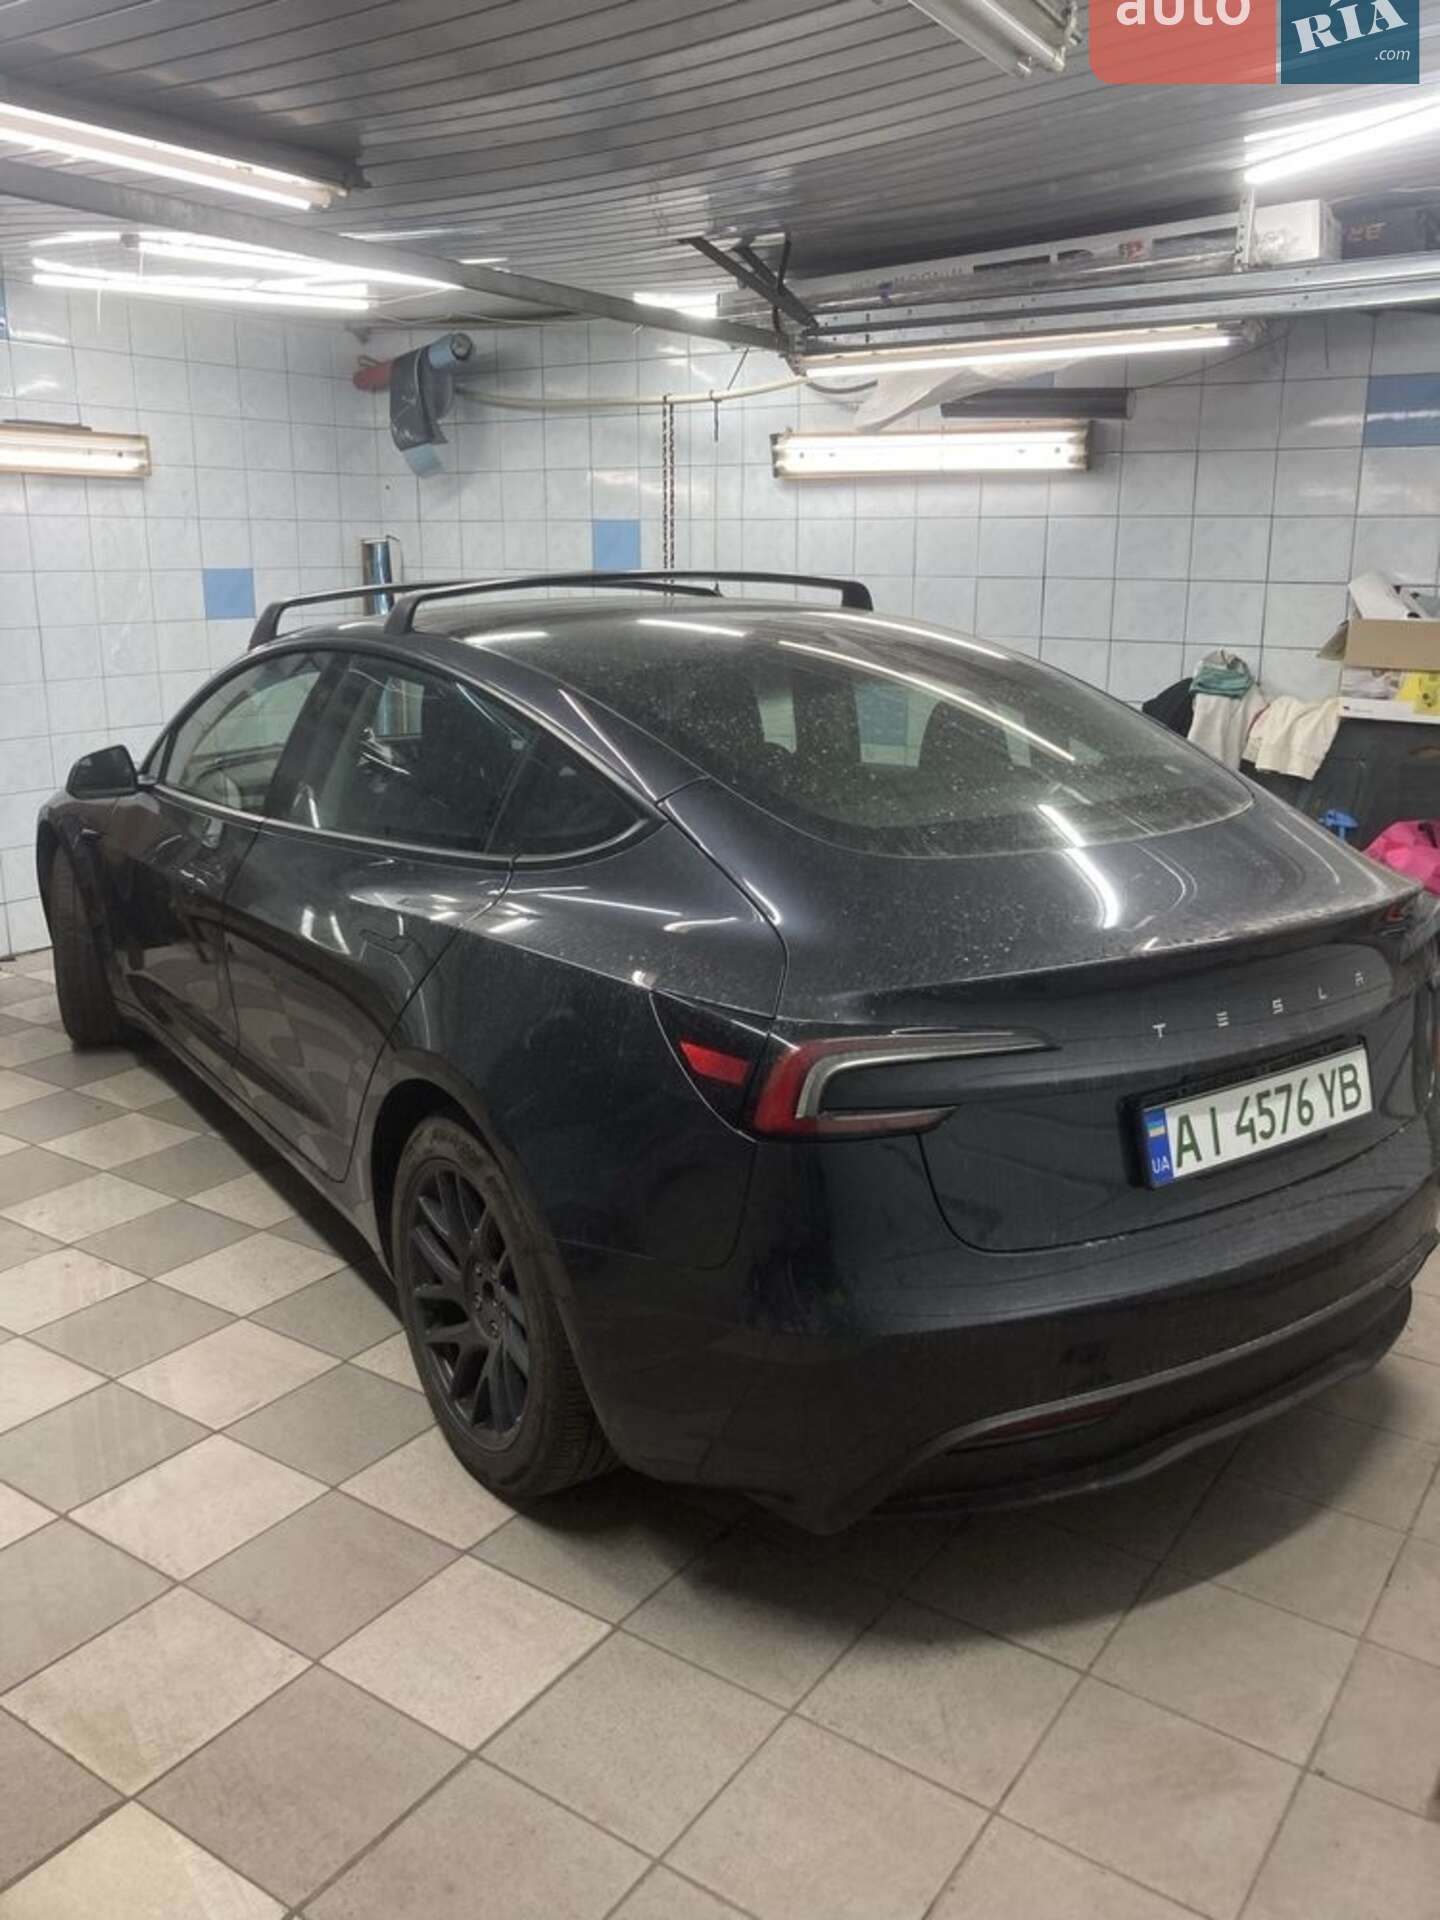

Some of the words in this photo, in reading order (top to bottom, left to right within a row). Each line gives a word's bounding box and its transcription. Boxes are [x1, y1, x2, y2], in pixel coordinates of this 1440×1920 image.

[1152, 971, 1365, 1038] TESLA
[1176, 1106, 1221, 1168] AI
[1235, 1078, 1314, 1144] 4576
[1319, 1063, 1362, 1118] YB
[1152, 1158, 1170, 1174] UA
